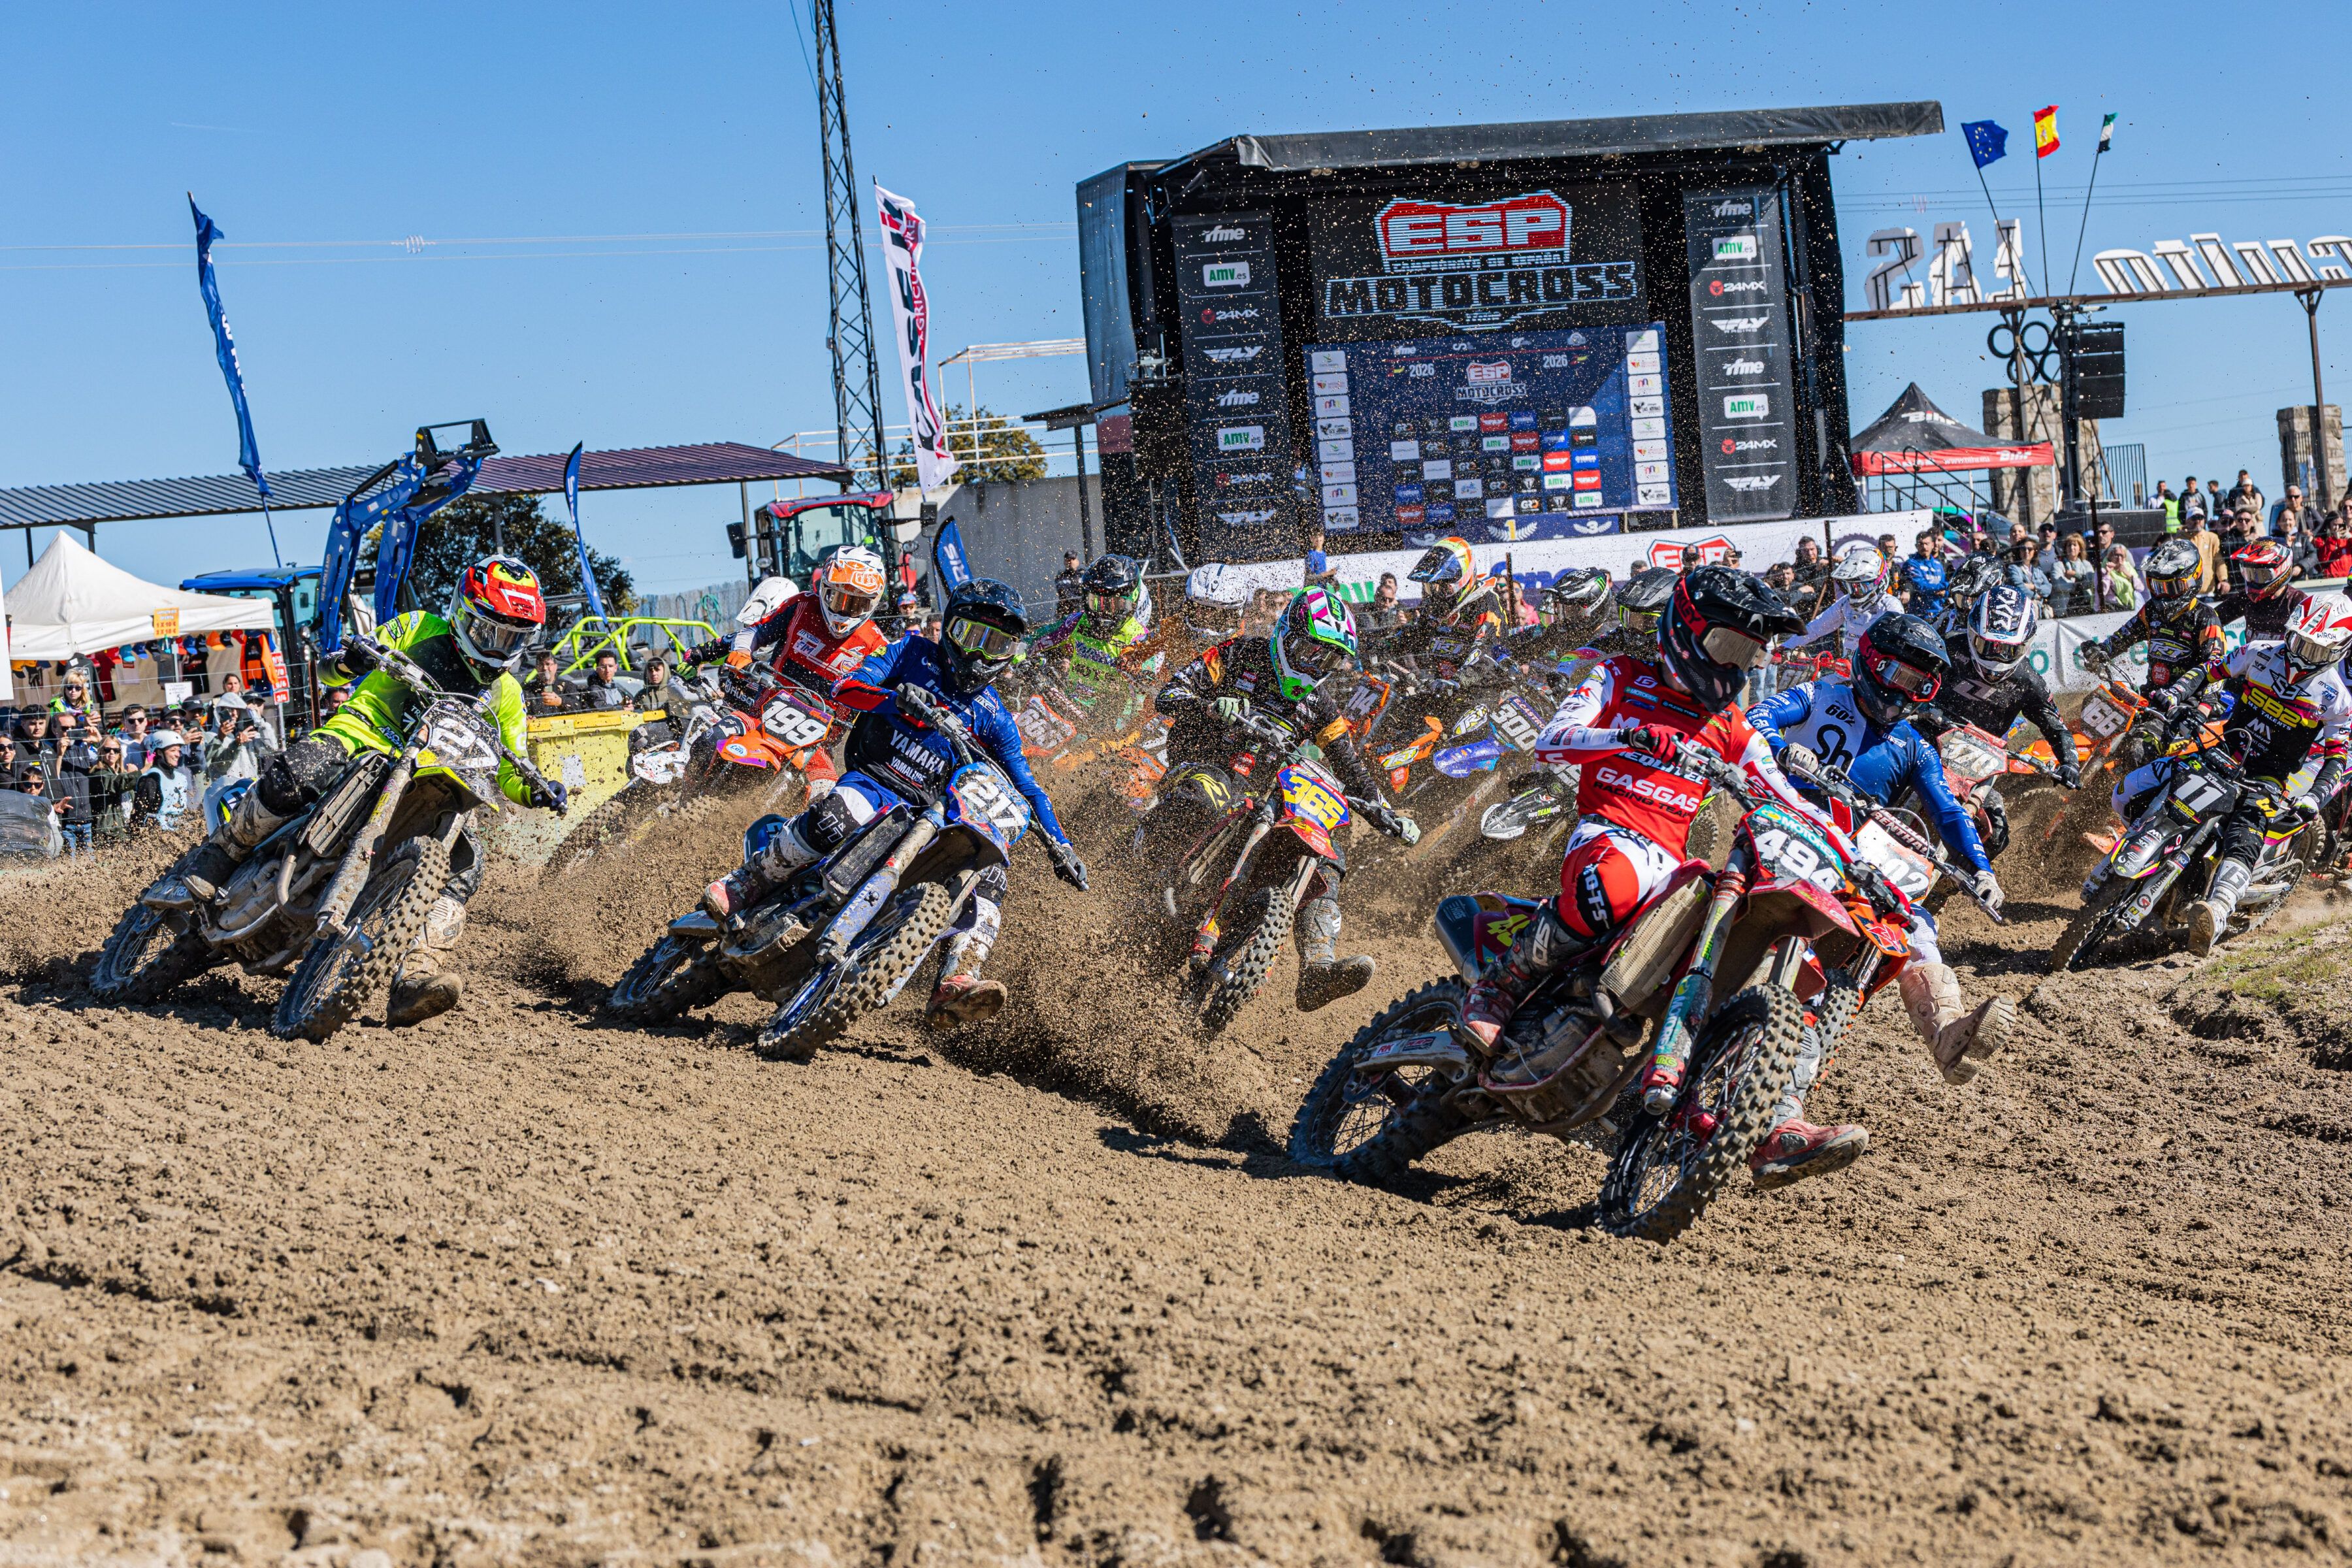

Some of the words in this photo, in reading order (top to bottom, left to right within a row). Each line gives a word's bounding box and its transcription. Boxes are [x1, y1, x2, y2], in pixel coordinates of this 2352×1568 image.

[1712, 200, 1752, 216] rfme
[1204, 225, 1245, 242] rfme
[1387, 208, 1562, 252] ESP
[1488, 255, 1505, 267] DE
[1328, 264, 1635, 316] MOTOCROSS
[1723, 281, 1765, 292] 24MX
[1216, 309, 1260, 319] 24MX
[1409, 363, 1434, 377] 2026
[1543, 355, 1568, 368] 2026
[1723, 358, 1765, 376] rfme
[1470, 365, 1510, 380] ESP
[1217, 389, 1260, 407] rfme
[1457, 384, 1526, 400] MOTOCROSS
[1735, 440, 1778, 450] 24MX
[1505, 519, 1516, 540] 1
[1587, 521, 1598, 533] 3
[1993, 587, 2017, 632] FXR
[1630, 689, 1658, 702] MOTOREX
[2322, 691, 2334, 700] FIM
[762, 700, 828, 746] 199
[1825, 704, 1855, 727] 602
[2247, 701, 2258, 710] MX
[2261, 711, 2291, 730] TALENTS
[1490, 703, 1539, 751] 300
[890, 730, 945, 775] YAMAHA
[1594, 781, 1653, 806] RACING
[1596, 767, 1699, 813] GASGAS
[2174, 774, 2223, 813] 11
[1284, 776, 1345, 831] 365
[1781, 817, 1837, 864] MOTOREX
